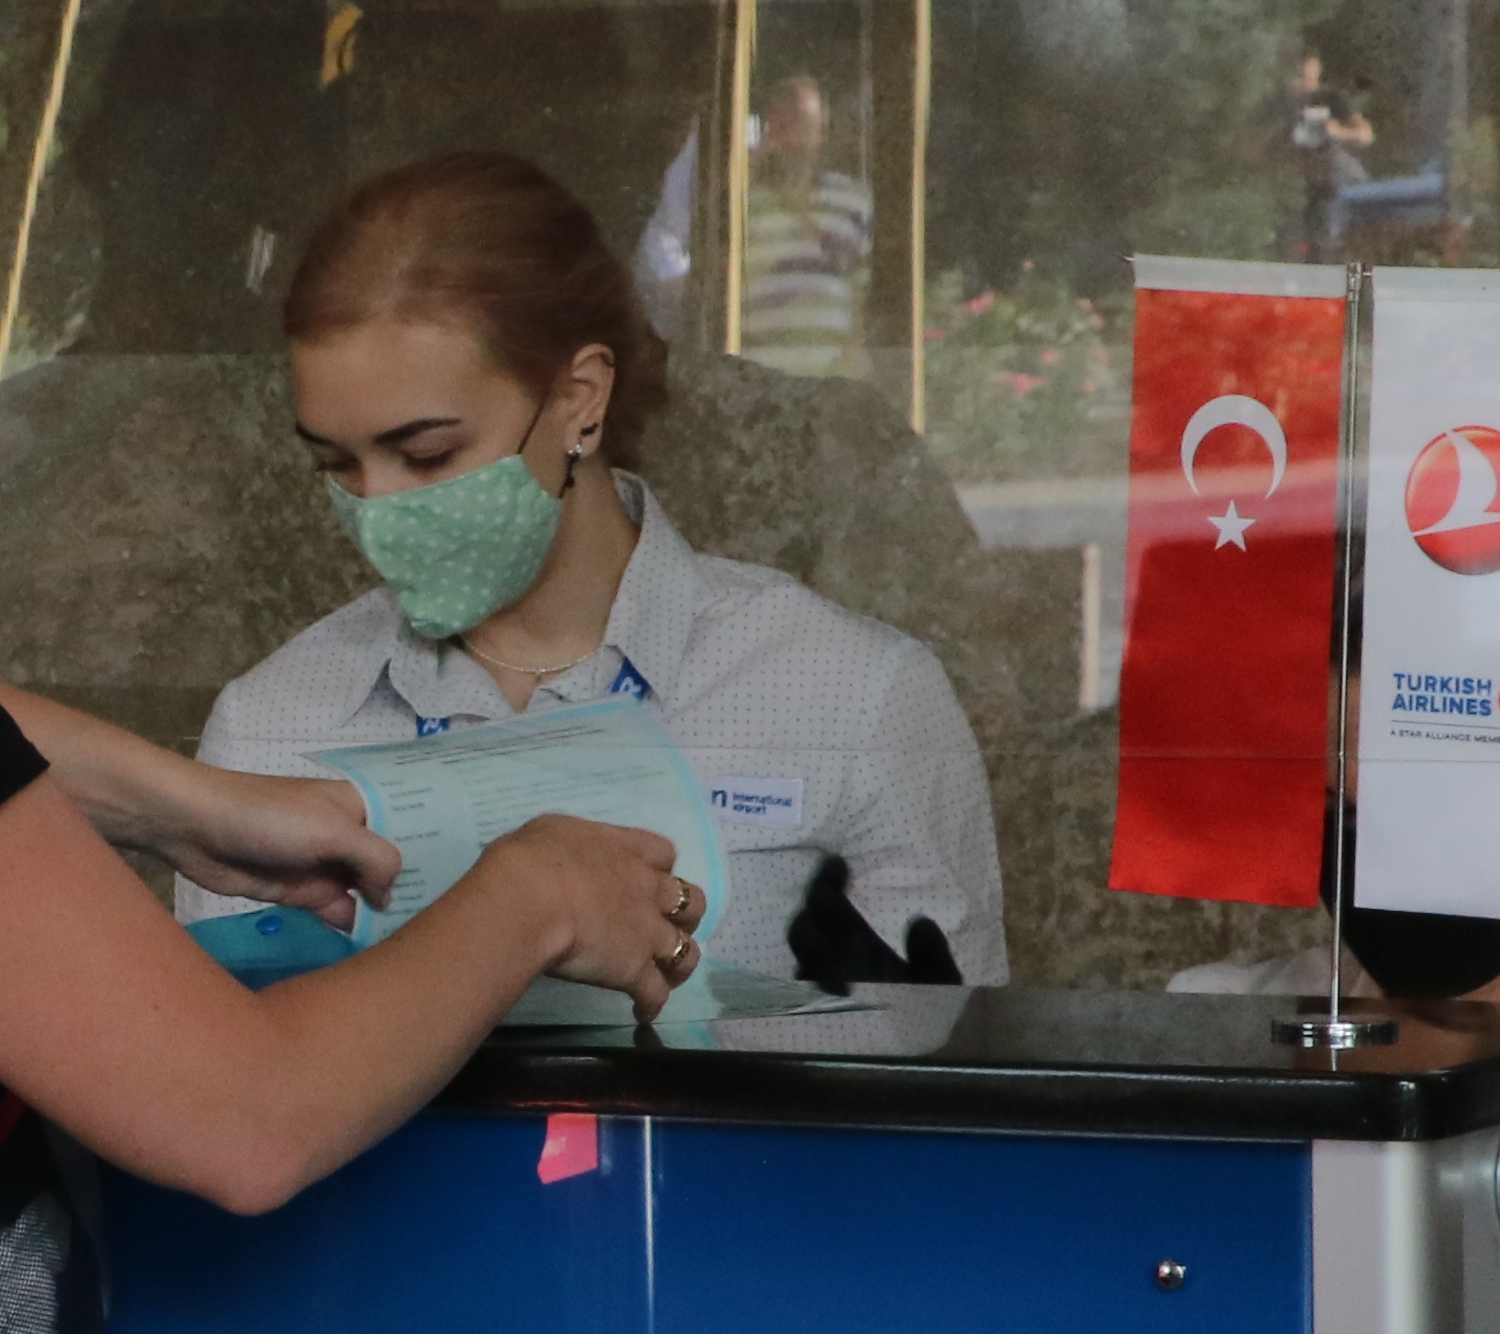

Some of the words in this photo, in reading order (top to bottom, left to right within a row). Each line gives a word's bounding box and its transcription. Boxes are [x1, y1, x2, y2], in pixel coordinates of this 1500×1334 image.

[1393, 673, 1493, 697] TURKISH
[1392, 693, 1492, 716] AIRLINES
[1399, 729, 1422, 738] STAR
[1425, 731, 1471, 742] ALLIANCE
